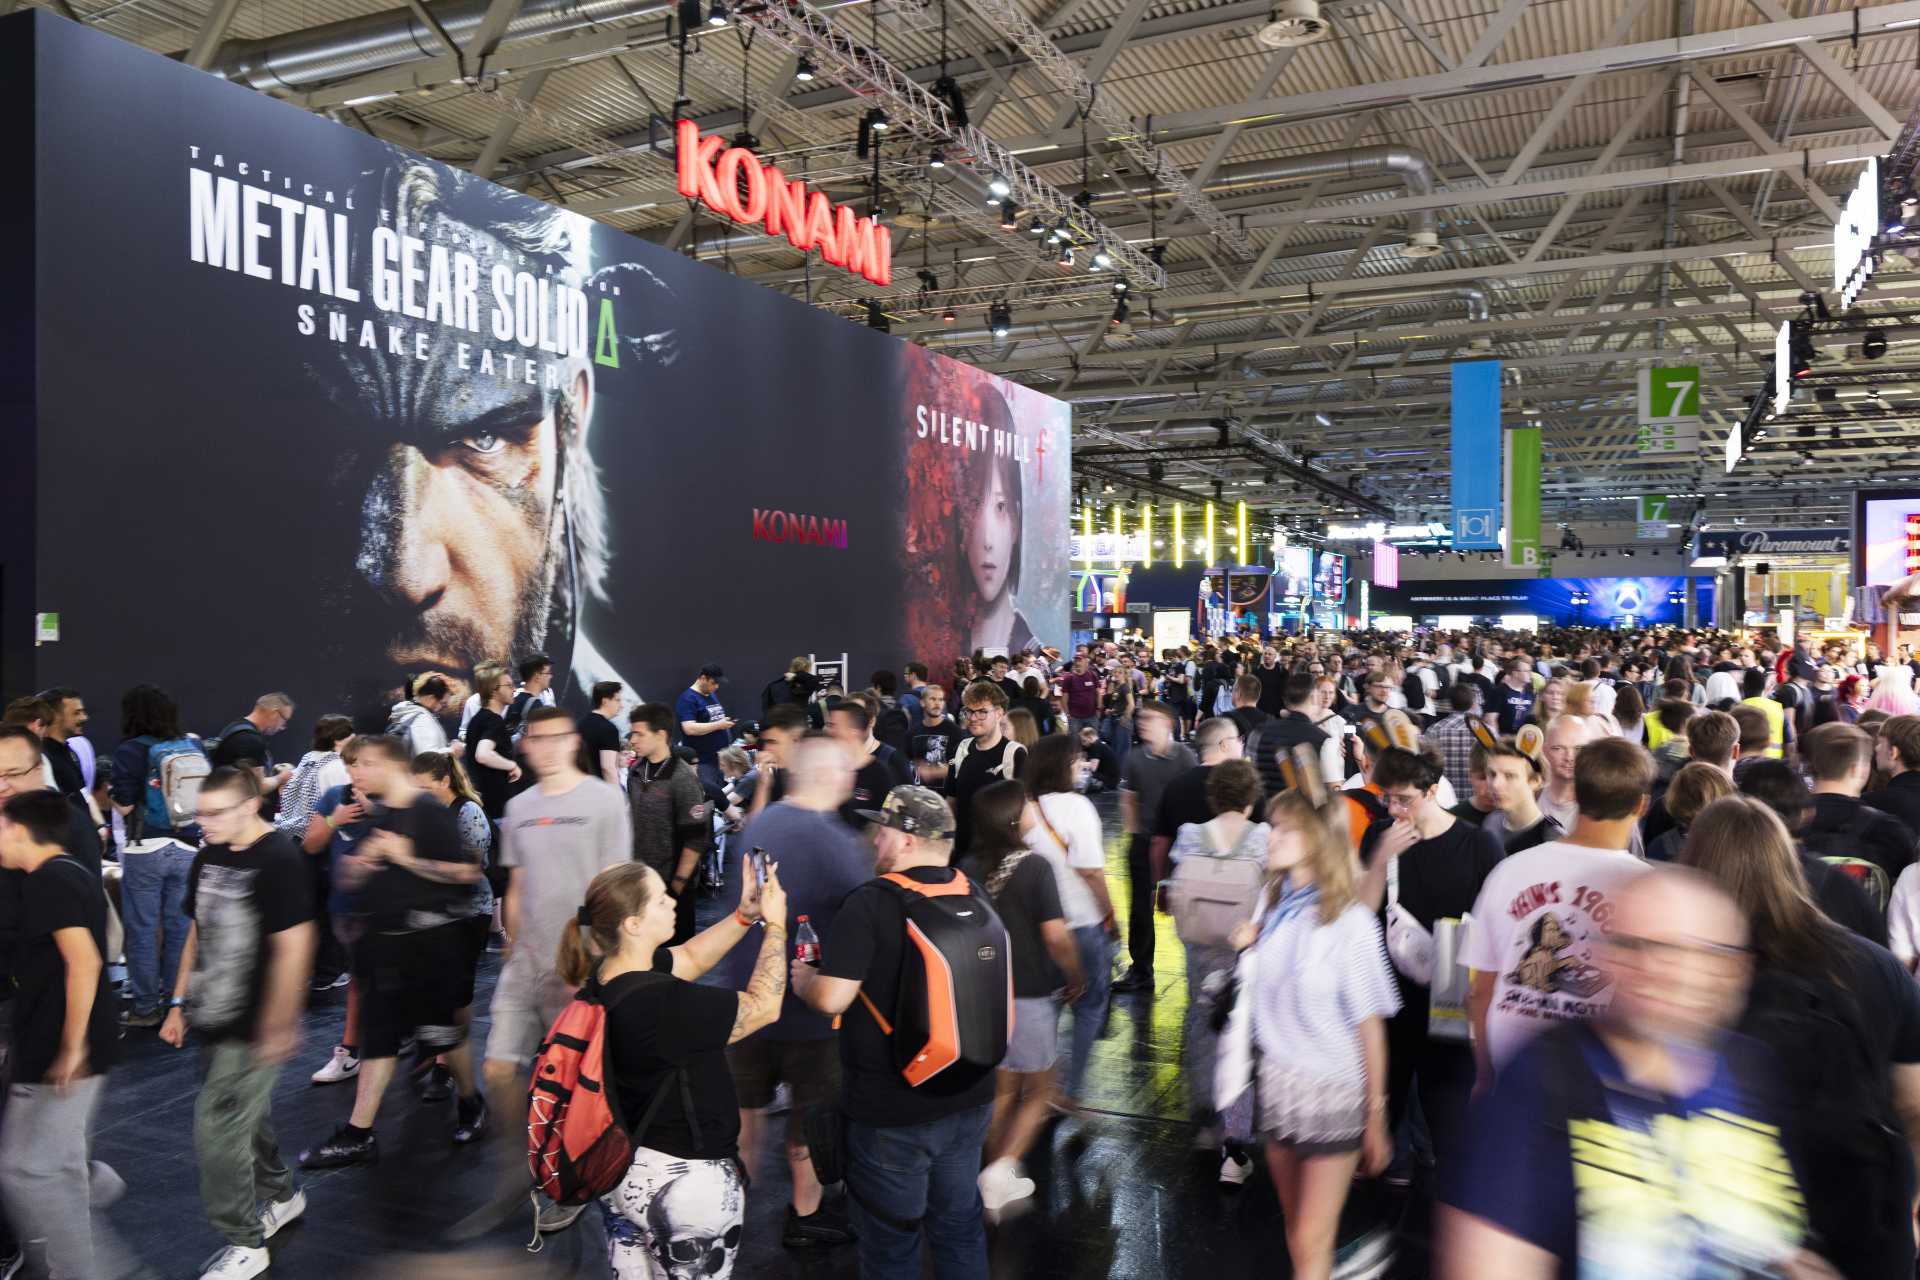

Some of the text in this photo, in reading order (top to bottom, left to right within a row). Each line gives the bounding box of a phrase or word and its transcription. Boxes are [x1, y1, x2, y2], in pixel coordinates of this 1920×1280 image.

[190, 146, 355, 209] TACTICAL
[546, 264, 621, 297] AION
[677, 119, 891, 286] KONAMI
[190, 168, 360, 302] METAL
[372, 227, 480, 332] GEAR
[491, 264, 589, 358] SOLID
[298, 305, 561, 390] SNAKE EATER
[1665, 381, 1695, 418] 7
[916, 404, 989, 453] SILENT
[994, 428, 1031, 463] HILL
[753, 508, 849, 549] KONAMI
[1651, 502, 1665, 521] 7
[1523, 547, 1537, 566] B
